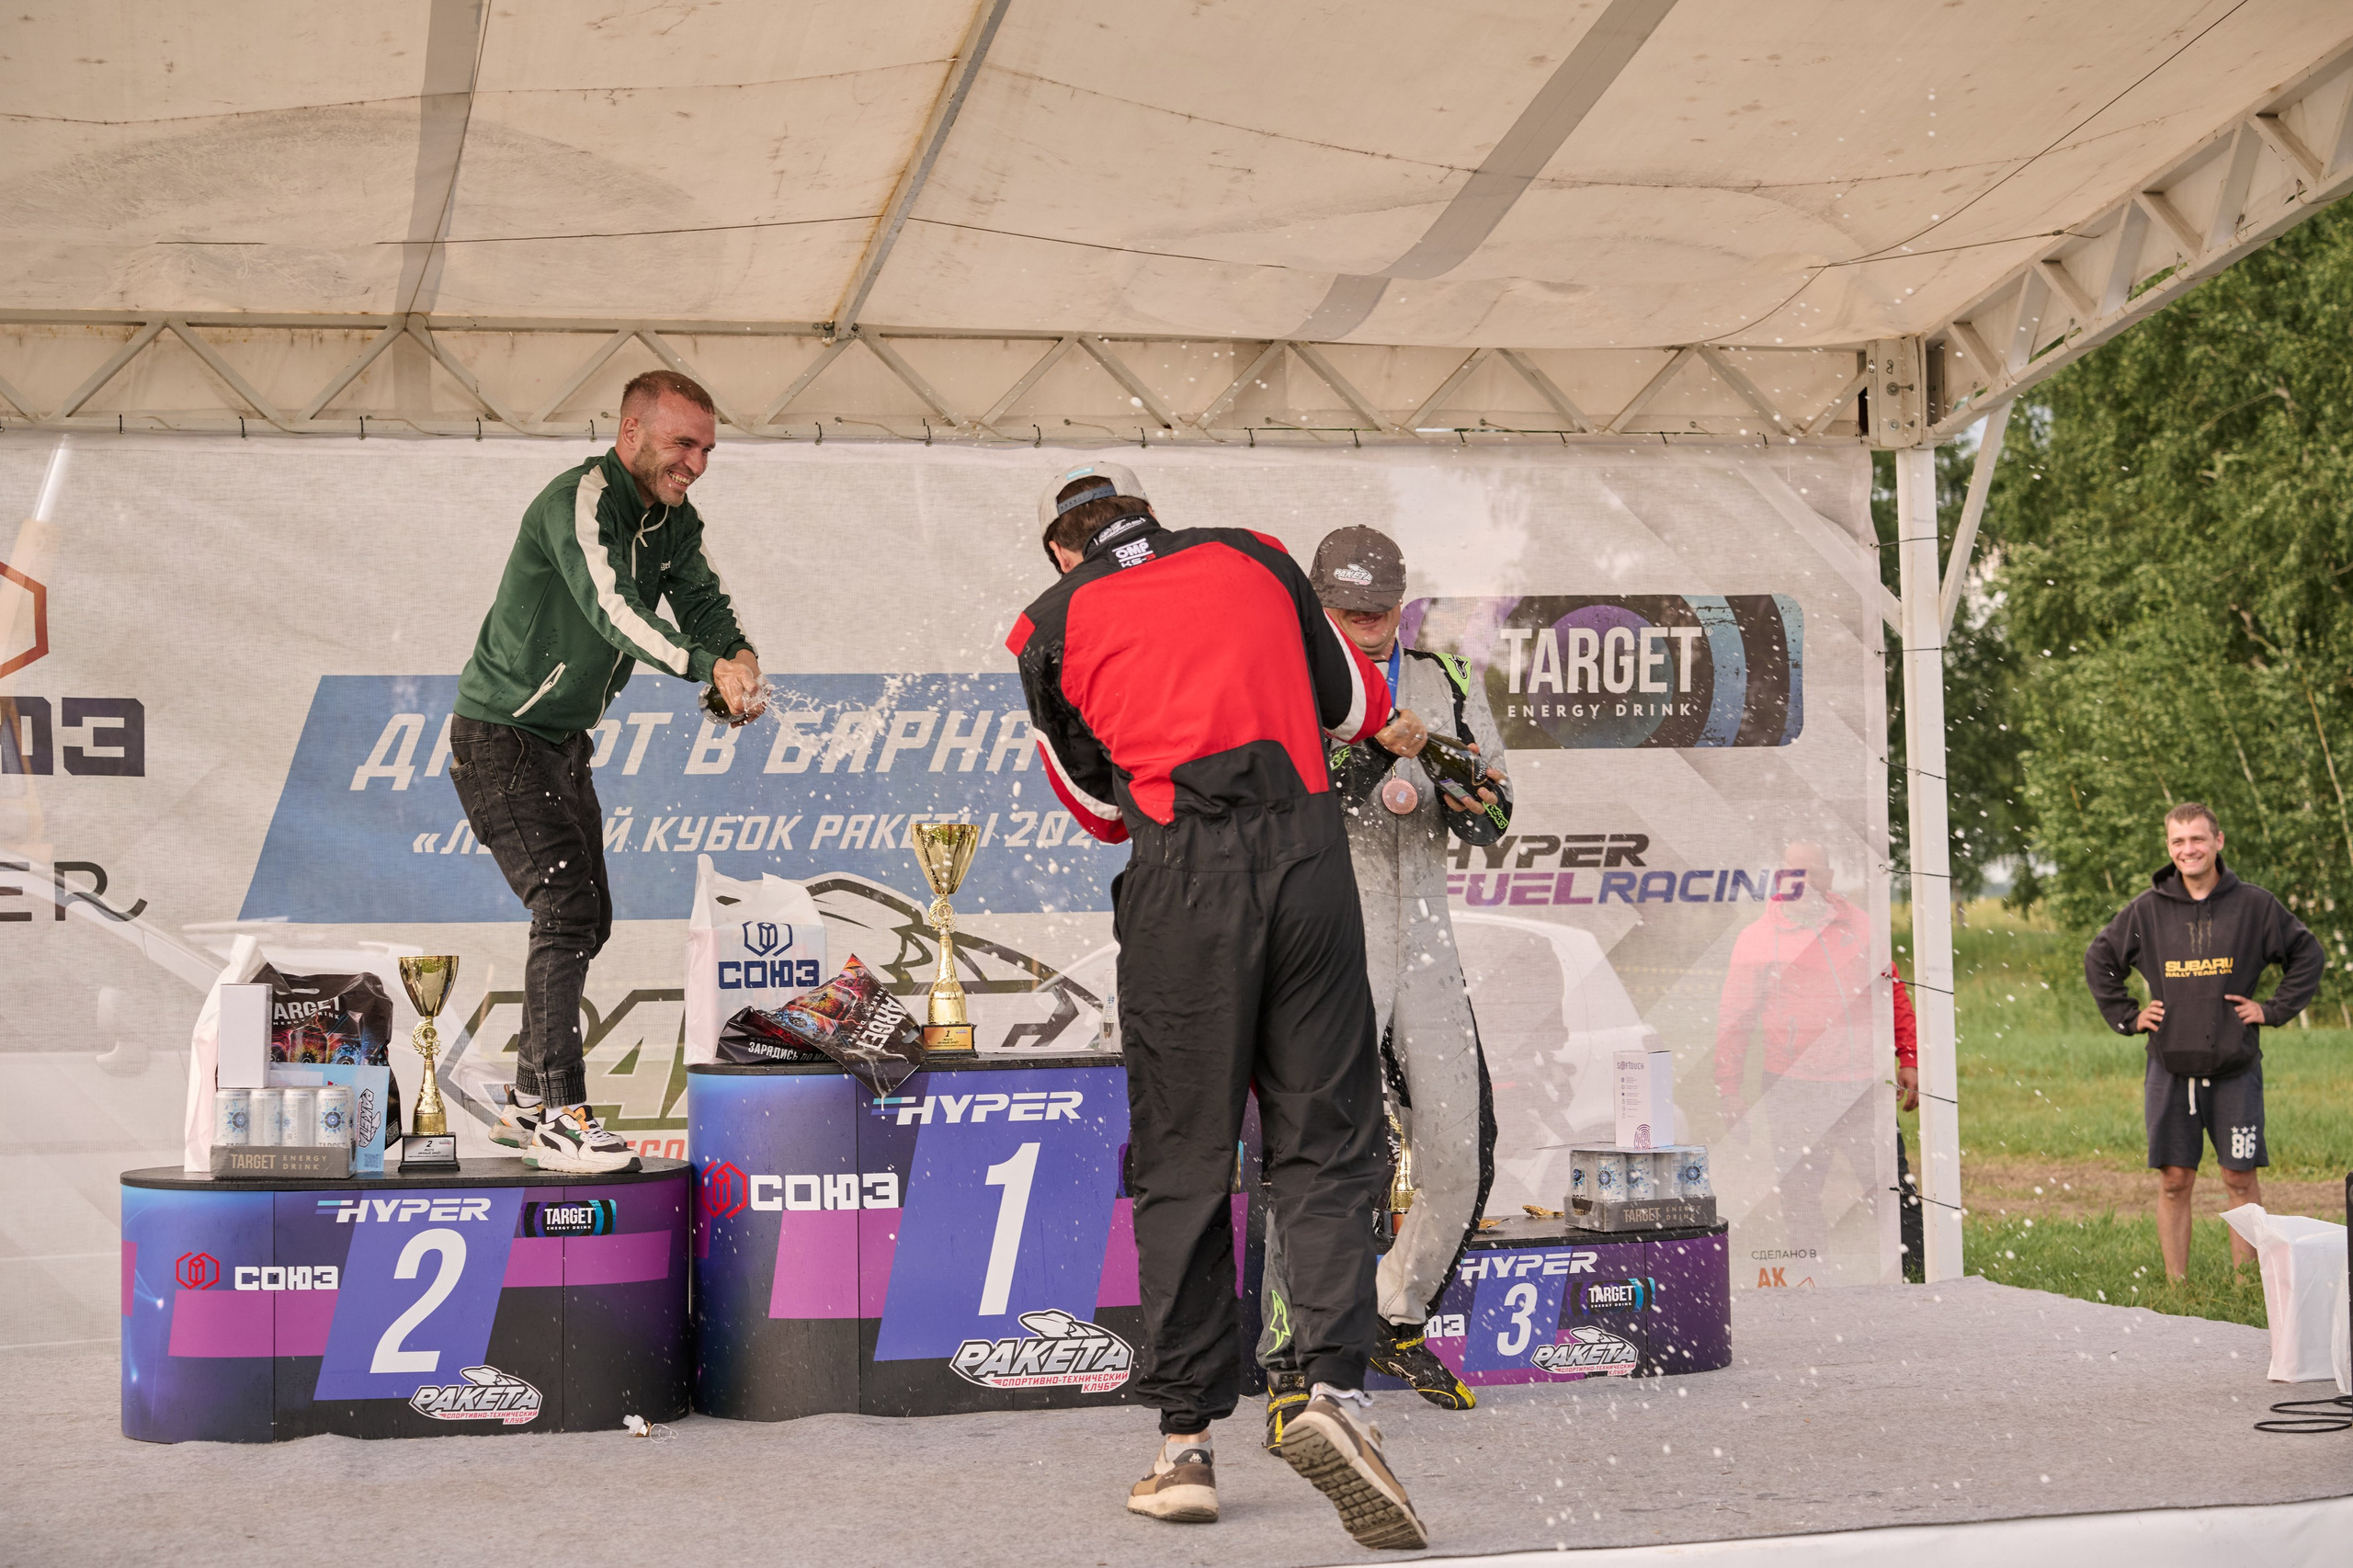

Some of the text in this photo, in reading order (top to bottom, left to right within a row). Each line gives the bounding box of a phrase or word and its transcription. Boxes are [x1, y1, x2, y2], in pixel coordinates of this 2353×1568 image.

[1115, 541, 1149, 559] OMP
[1334, 568, 1373, 582] РАКЕТА
[1500, 627, 1702, 694] TARGET
[1507, 703, 1691, 718] ENERGY DRINK
[763, 710, 1046, 774] БАРНА
[642, 815, 803, 853] КУБОК
[1004, 811, 1123, 847] 202
[718, 959, 820, 989] СОЮЗ
[2165, 957, 2234, 972] SUBARU
[274, 995, 340, 1020] ARGET
[847, 1020, 867, 1042] DRINK
[856, 995, 908, 1051] ARGET
[748, 1041, 799, 1061] ЗАРЯДИСЬ
[896, 1090, 1084, 1126] HYPER
[426, 1140, 433, 1148] 2
[2231, 1132, 2257, 1160] 86
[231, 1153, 328, 1170] TARGET ENERGY
[750, 1172, 900, 1211] СОЮЗ
[335, 1198, 492, 1223] HYPER
[544, 1207, 595, 1225] TARGET
[1623, 1207, 1661, 1223] TARGET
[1665, 1213, 1697, 1221] DRINK
[978, 1142, 1041, 1316] 1
[1461, 1251, 1598, 1280] HYPER
[1751, 1248, 1817, 1261] СДЕЛАНО В
[234, 1266, 339, 1290] СОЮЗ
[369, 1228, 468, 1374] 2
[1588, 1285, 1634, 1303] TARGET
[1496, 1282, 1538, 1357] 3
[952, 1337, 1130, 1378] РАКЕТА
[1531, 1341, 1636, 1369] РАКЕТА
[1001, 1370, 1129, 1387] СПОРТИВНО-ТЕХНИЧЕСКИЙ
[1083, 1381, 1110, 1392] КЛУБ
[410, 1385, 541, 1412] РАКЕТА
[446, 1410, 539, 1420] СПОРТИВНО-ТЕХНИЧЕСКИЙ
[505, 1416, 525, 1425] КЛУБ
